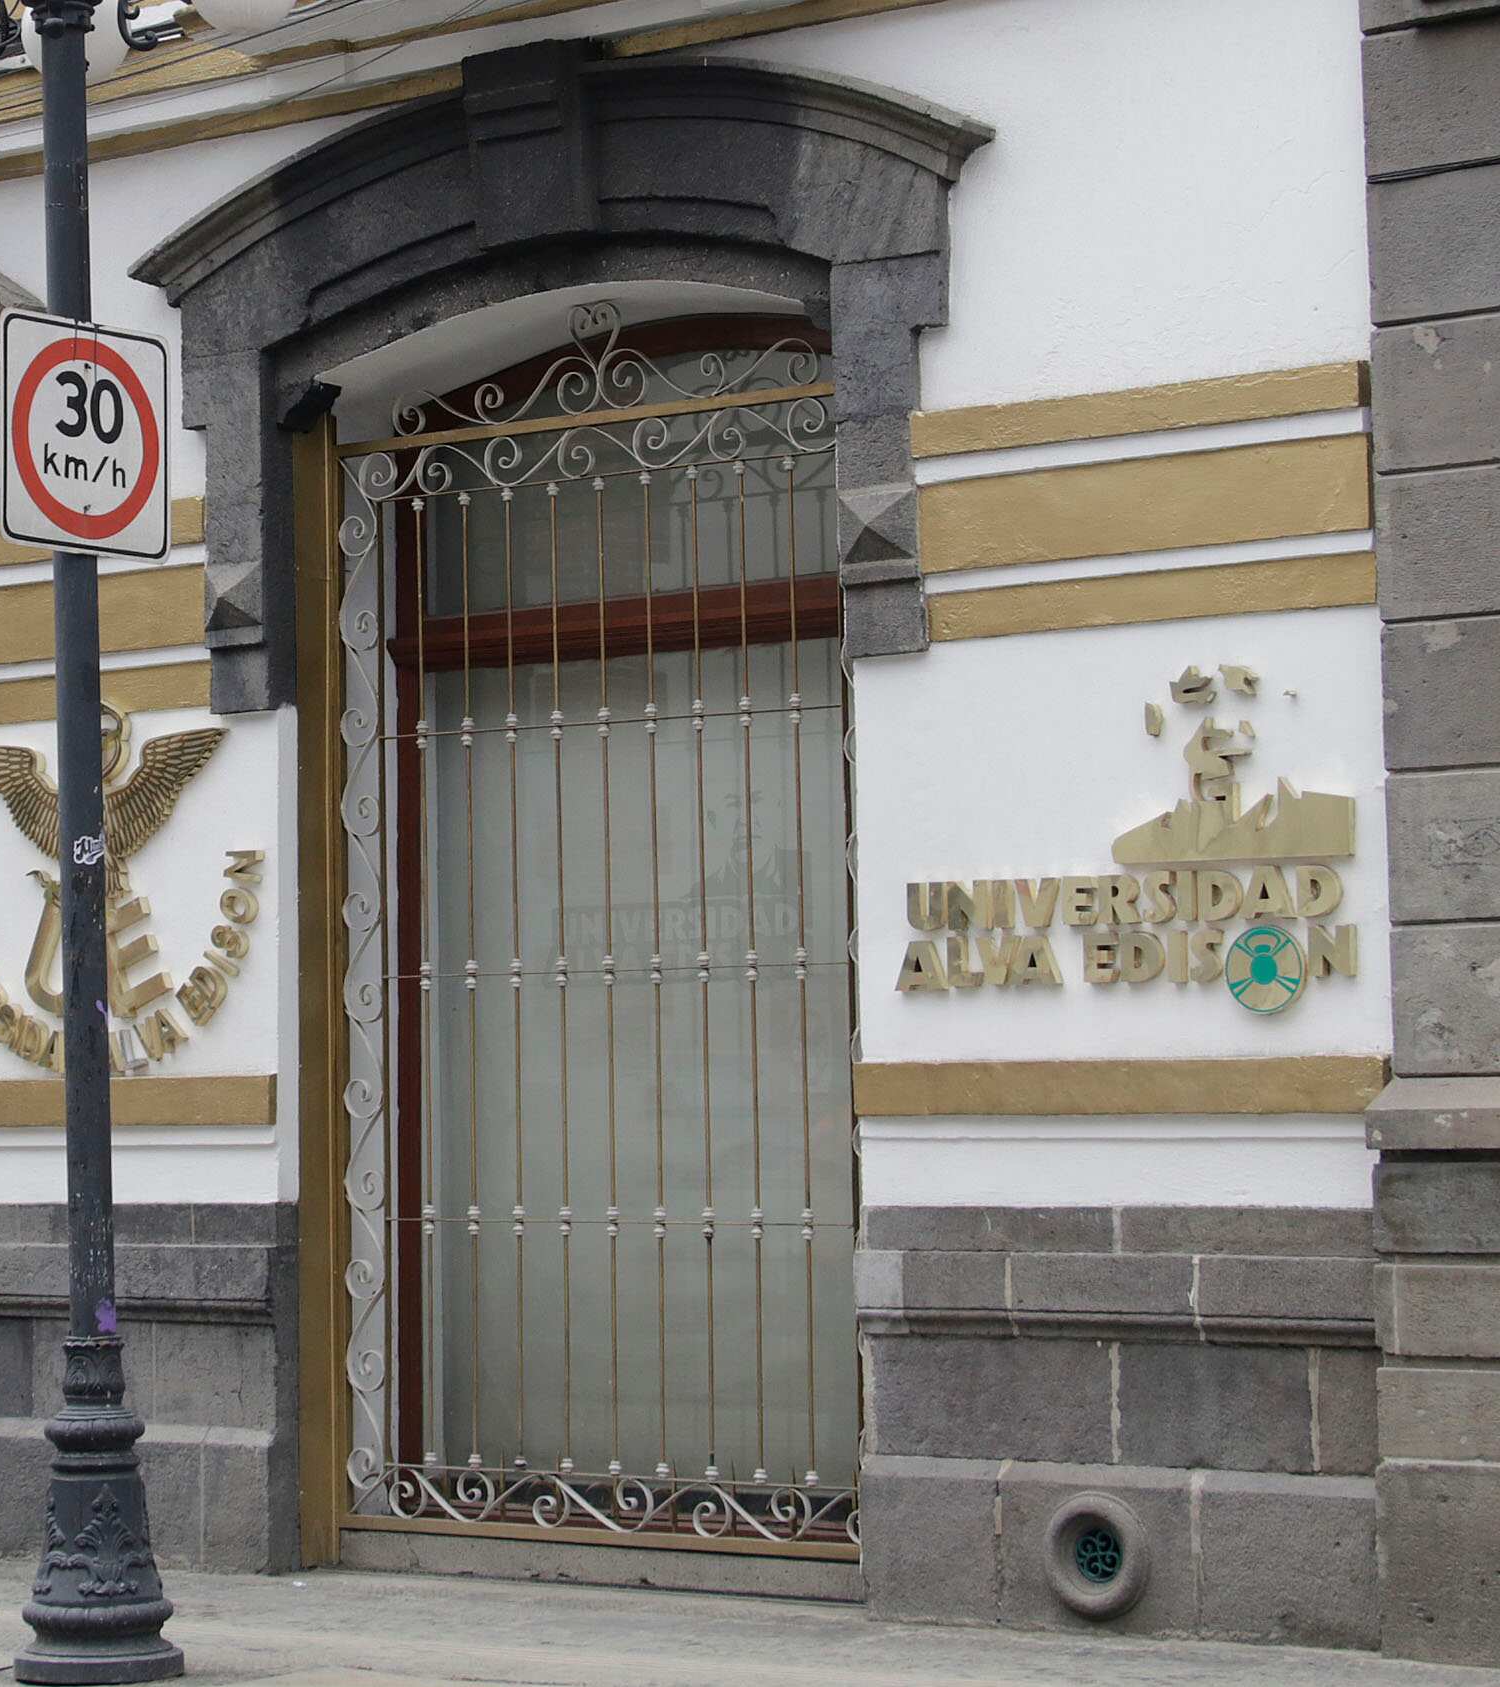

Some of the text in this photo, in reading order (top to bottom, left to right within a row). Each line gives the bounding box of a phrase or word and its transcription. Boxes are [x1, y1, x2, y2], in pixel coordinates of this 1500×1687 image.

[55, 371, 124, 444] 30
[44, 443, 126, 488] km/h
[906, 864, 1344, 931] UNIVERSIDAD
[175, 849, 266, 1028] EDISON
[895, 934, 1064, 993] ALVA
[1082, 924, 1358, 1015] EDISON
